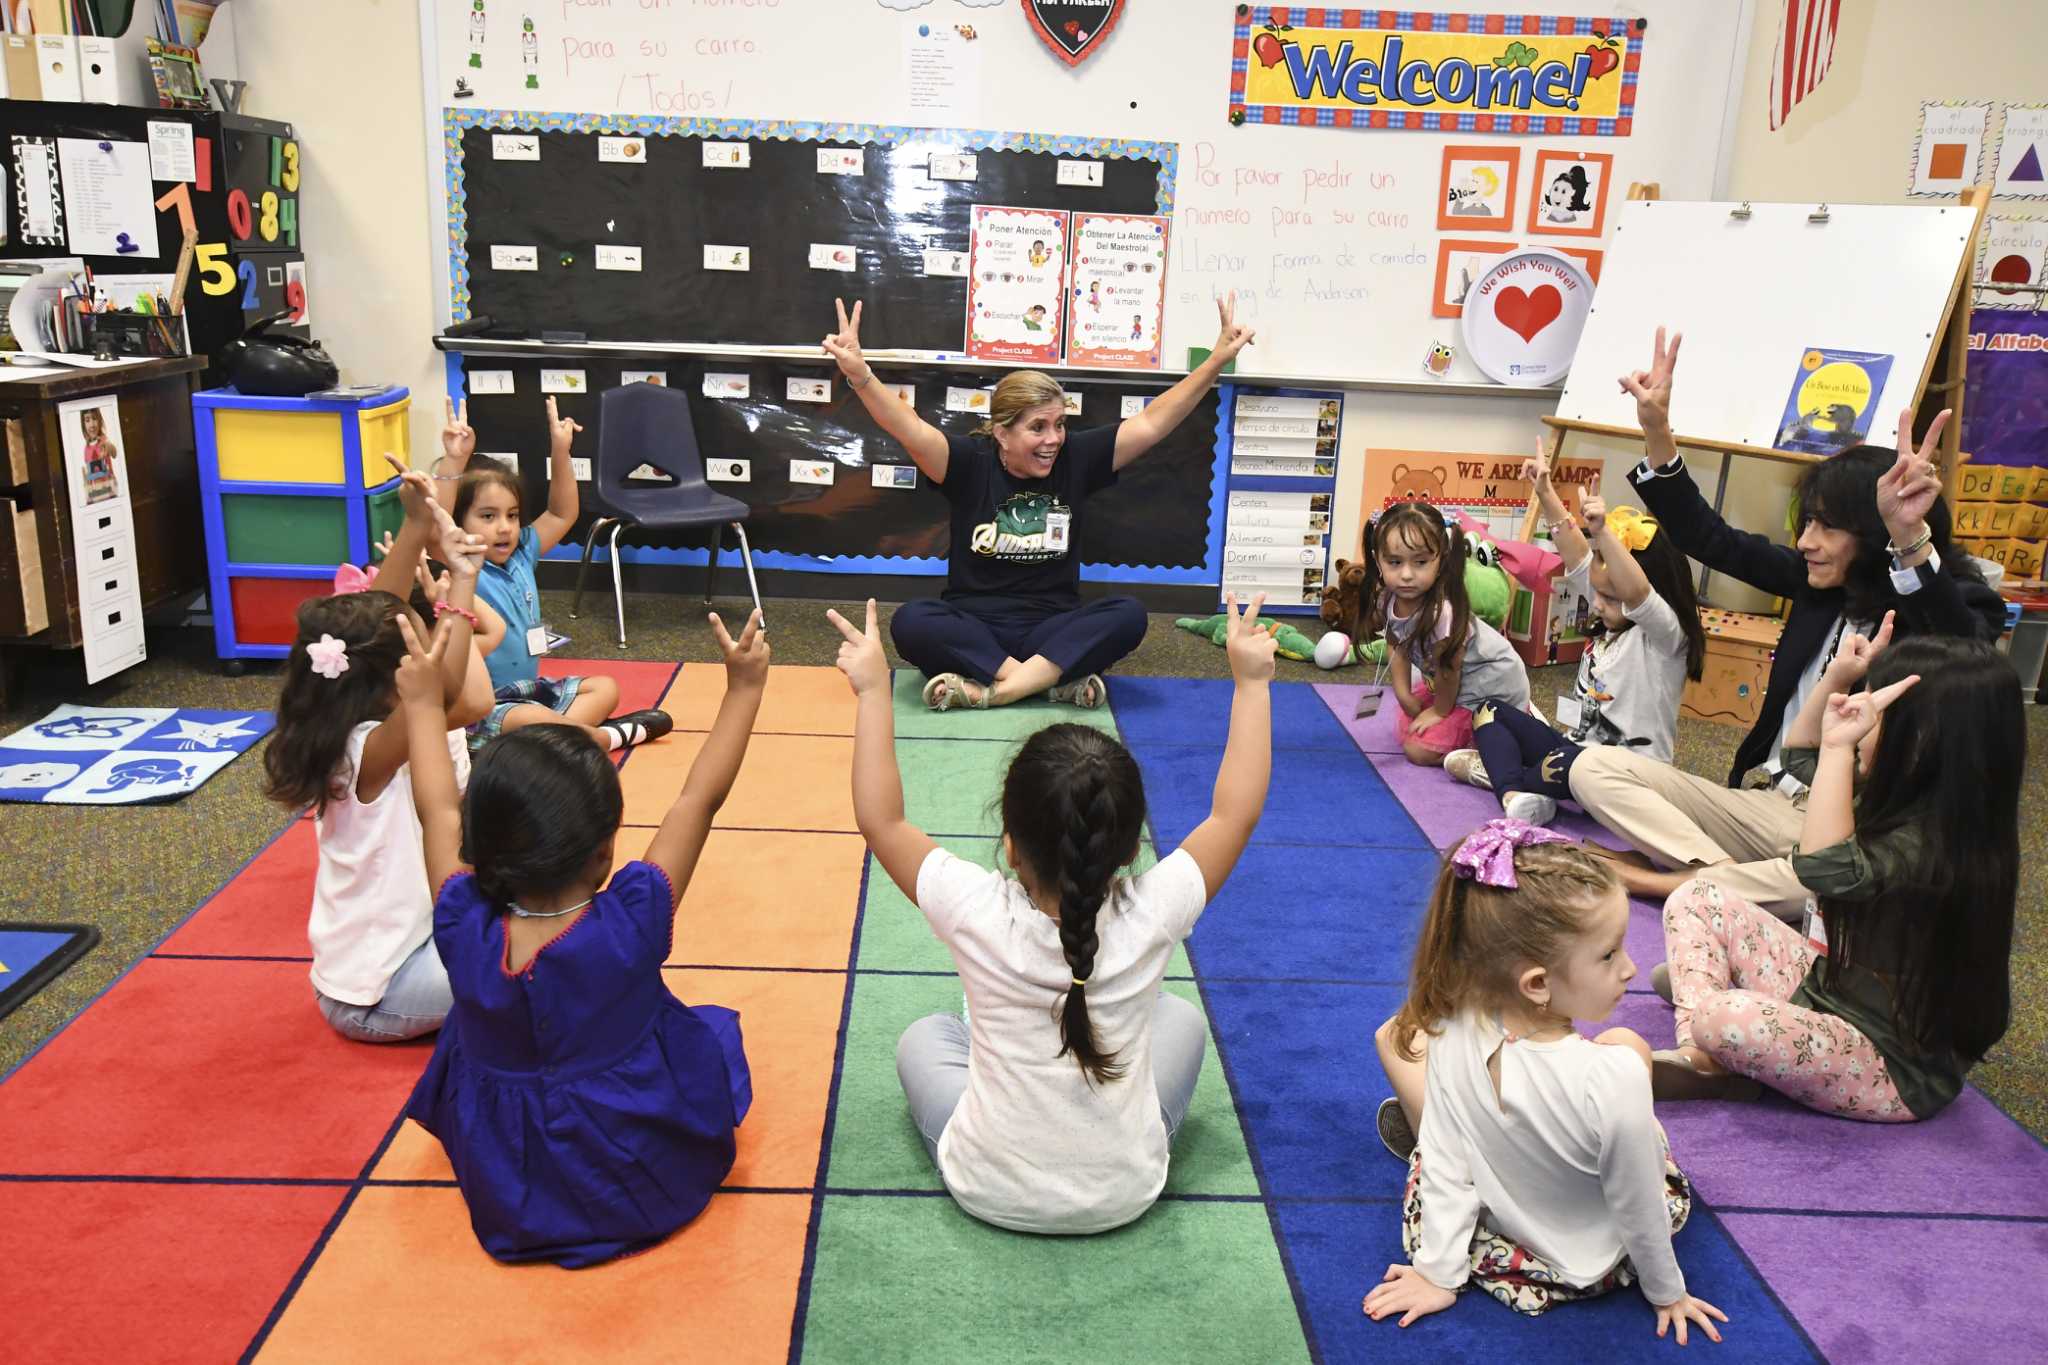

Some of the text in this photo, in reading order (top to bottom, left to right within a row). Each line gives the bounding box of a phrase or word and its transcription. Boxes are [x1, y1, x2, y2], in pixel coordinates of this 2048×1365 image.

[562, 37, 616, 77] para
[639, 40, 668, 58] su
[1281, 35, 1592, 110] Welcome!
[210, 79, 247, 113] V
[155, 124, 185, 138] Spring
[1924, 124, 1983, 135] cuadrado
[602, 143, 619, 156] Bb
[705, 147, 723, 161] Cc
[1194, 142, 1222, 187] Por
[1303, 160, 1352, 204] pedir
[1370, 172, 1395, 190] un
[989, 223, 1014, 234] Poner
[1185, 206, 1409, 238] numero para su carro
[1086, 230, 1115, 240] Obtener
[1117, 231, 1126, 240] La
[1096, 242, 1108, 250] Del
[1336, 243, 1355, 267] de
[1369, 243, 1427, 266] comida
[195, 243, 236, 295] 5
[1480, 259, 1577, 295] We Wish You Well
[239, 260, 260, 309] 2
[1115, 286, 1144, 295] Levantar
[1456, 461, 1484, 479] WE
[1484, 485, 1497, 498] M
[1227, 550, 1268, 564] Dormir
